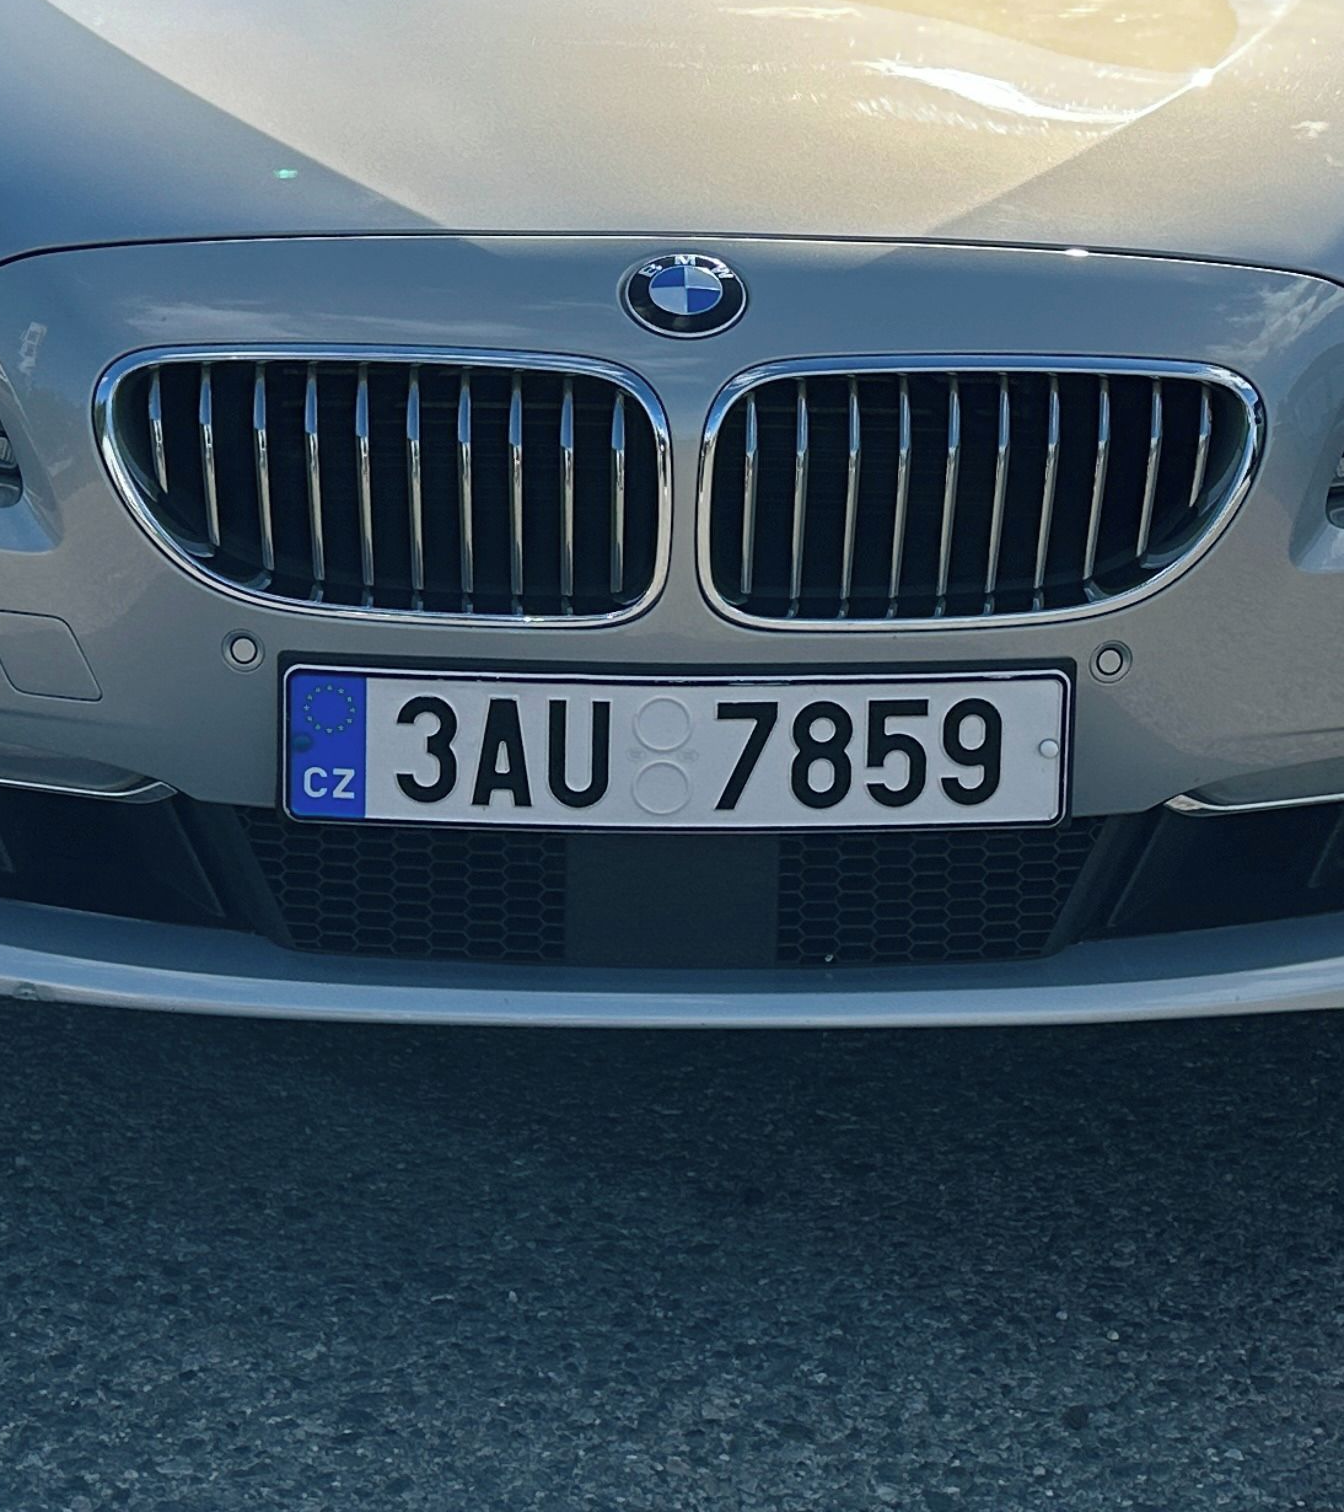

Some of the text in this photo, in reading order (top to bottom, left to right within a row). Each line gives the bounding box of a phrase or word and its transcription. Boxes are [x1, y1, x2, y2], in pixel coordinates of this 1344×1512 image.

[639, 253, 734, 279] BMW
[395, 694, 1004, 811] 3AU 7859
[303, 766, 356, 799] CZ
